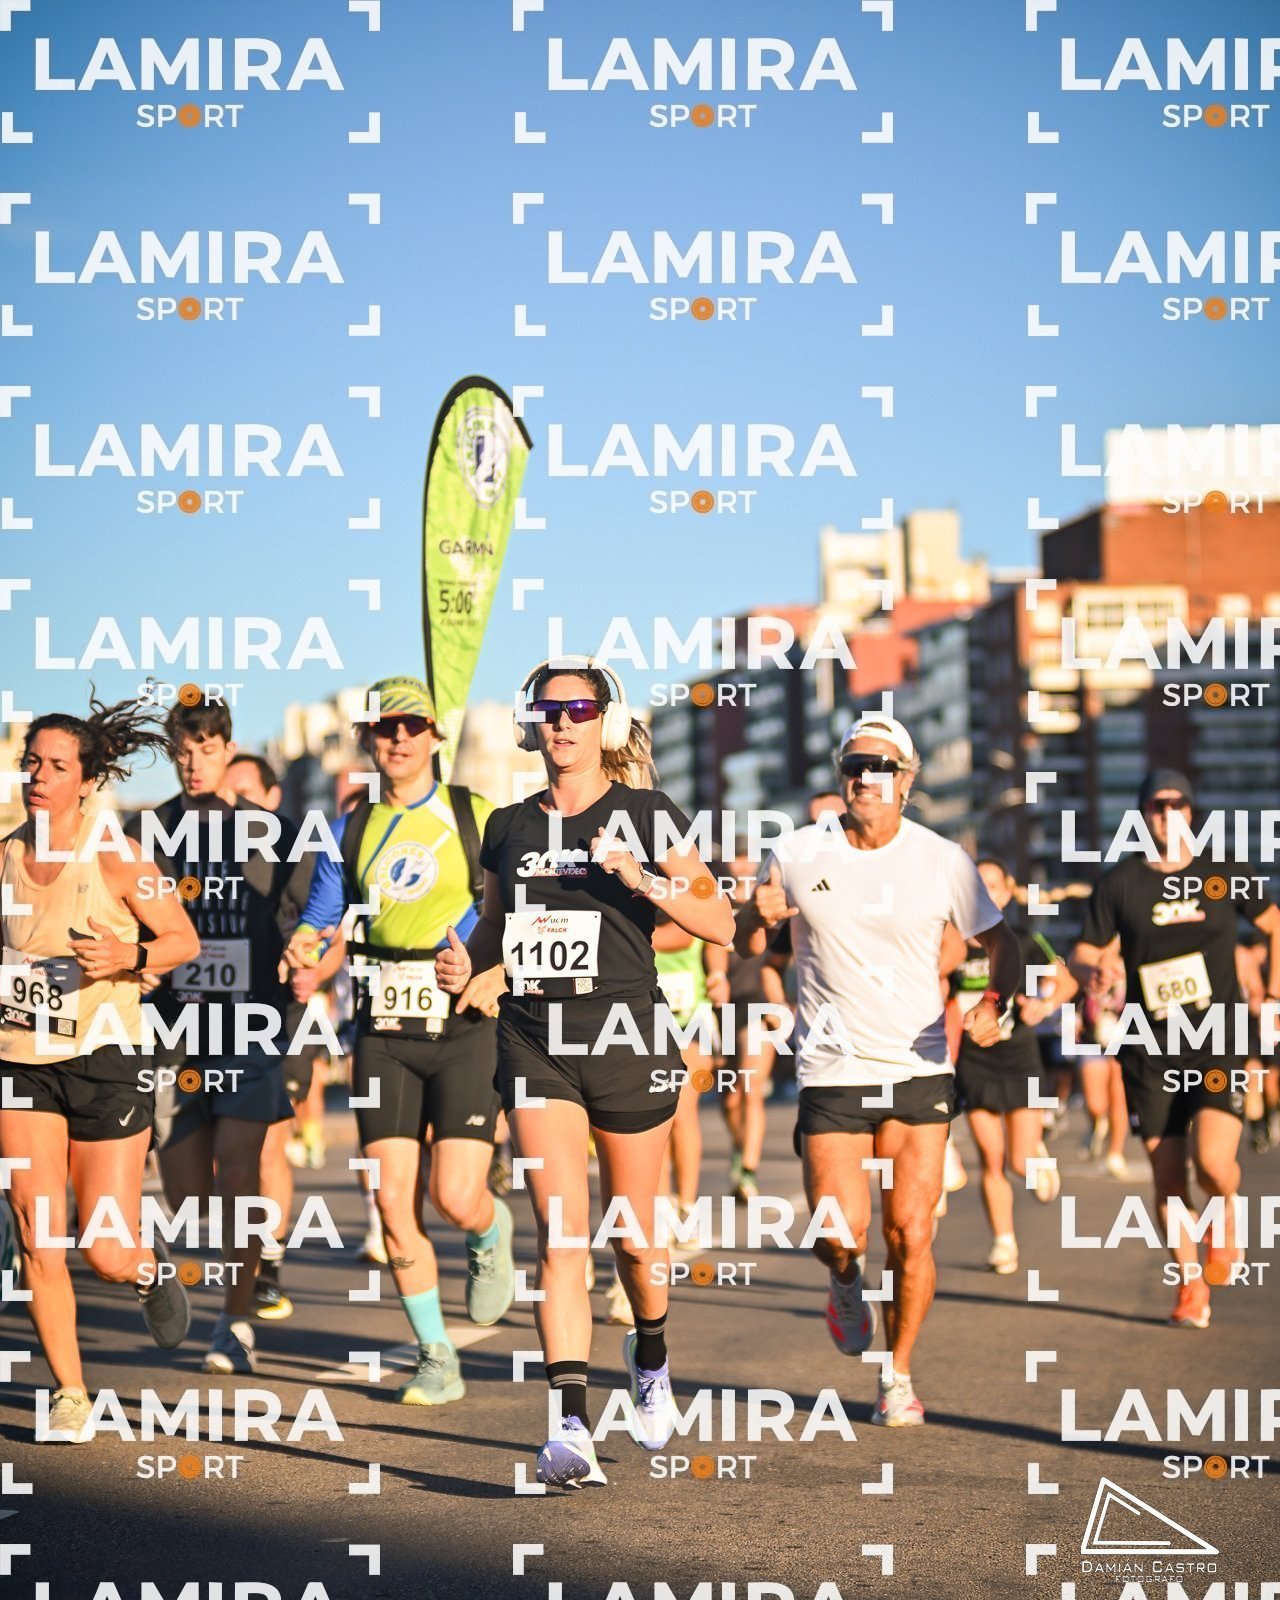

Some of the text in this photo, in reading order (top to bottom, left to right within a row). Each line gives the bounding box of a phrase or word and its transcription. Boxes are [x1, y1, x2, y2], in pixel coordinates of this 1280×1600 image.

[439, 539, 493, 555] GARMN
[511, 940, 589, 971] 1102
[185, 963, 236, 987] 210
[13, 977, 63, 1012] 968
[384, 986, 432, 1011] 916
[1157, 977, 1198, 1002] 680
[4, 1007, 29, 1023] 30K
